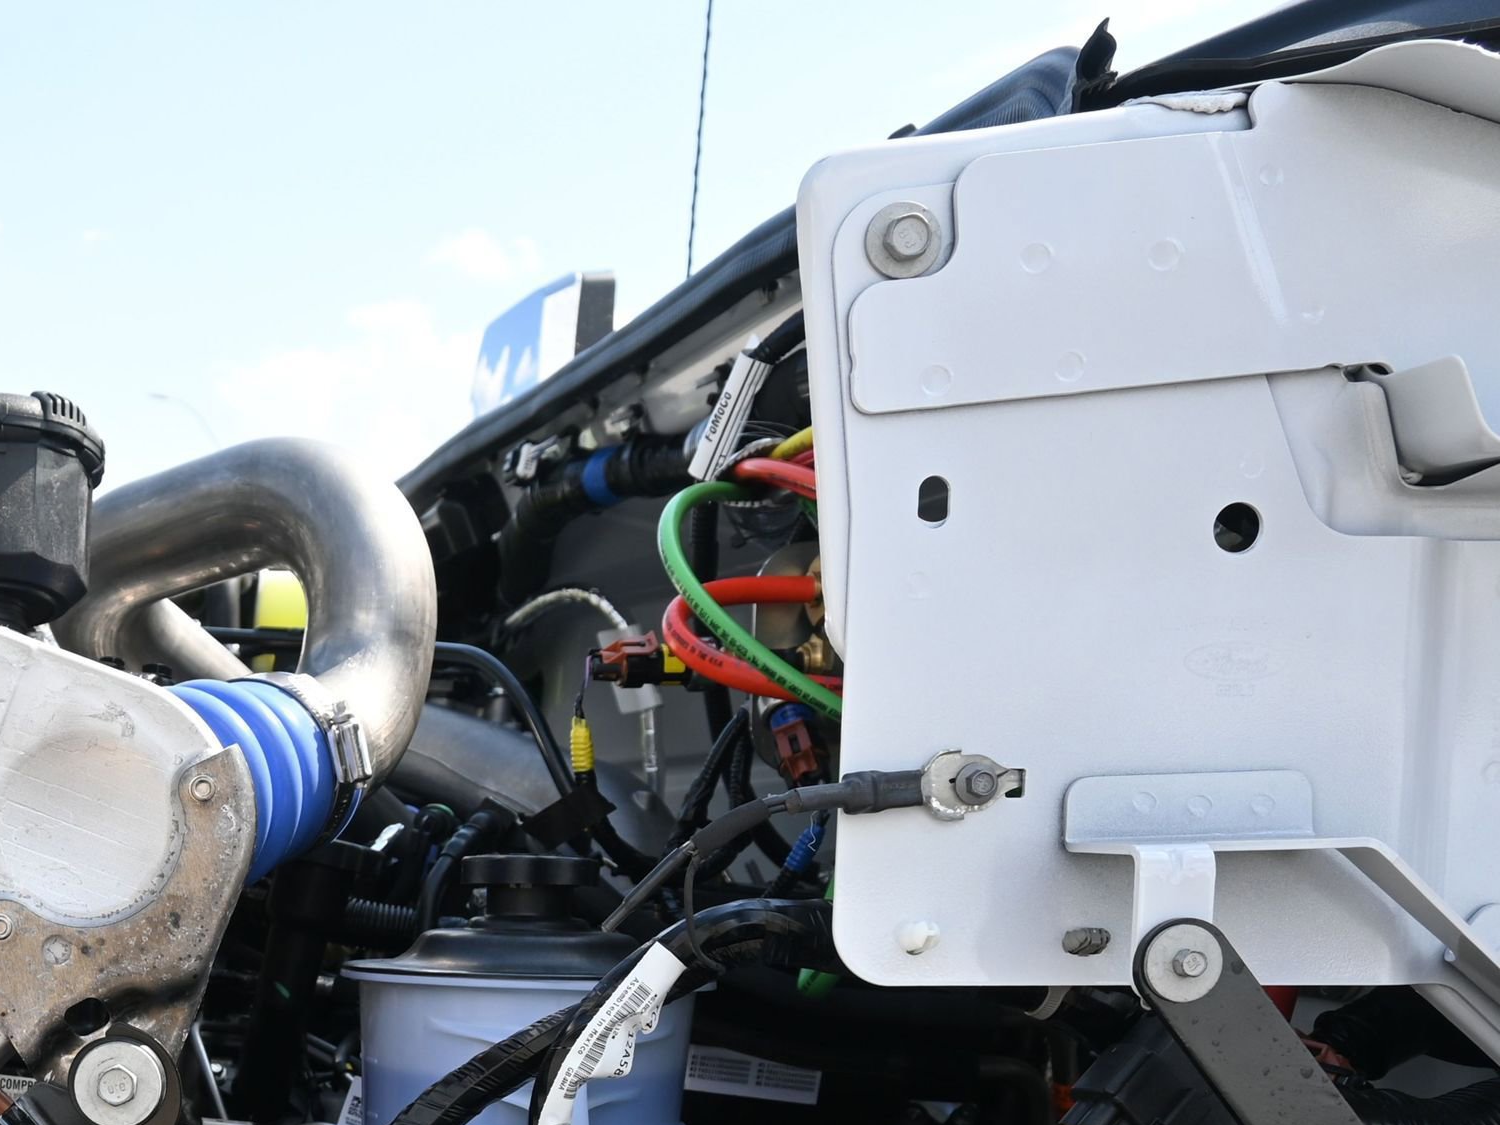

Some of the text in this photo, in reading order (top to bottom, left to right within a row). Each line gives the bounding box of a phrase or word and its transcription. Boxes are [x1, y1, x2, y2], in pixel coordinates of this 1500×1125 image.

[577, 977, 640, 1056] Assembled in Mexico
[0, 1077, 35, 1091] COMPR
